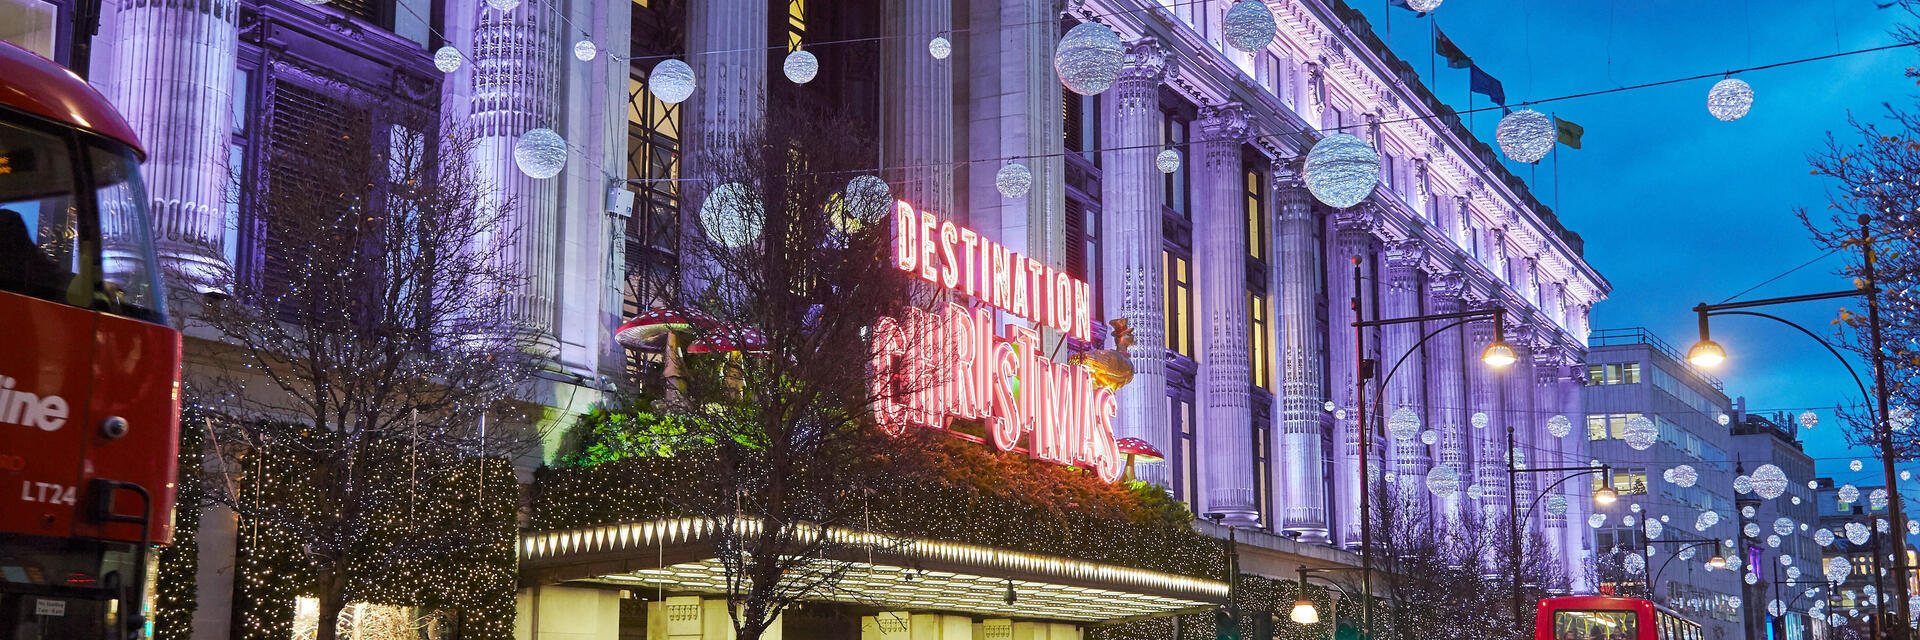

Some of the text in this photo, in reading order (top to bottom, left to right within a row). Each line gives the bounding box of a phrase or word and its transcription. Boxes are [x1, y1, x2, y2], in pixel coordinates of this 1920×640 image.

[897, 200, 1091, 342] DESTINATION
[0, 375, 69, 432] ine
[872, 302, 1121, 484] CHRISTMAS
[21, 480, 77, 506] LT24
